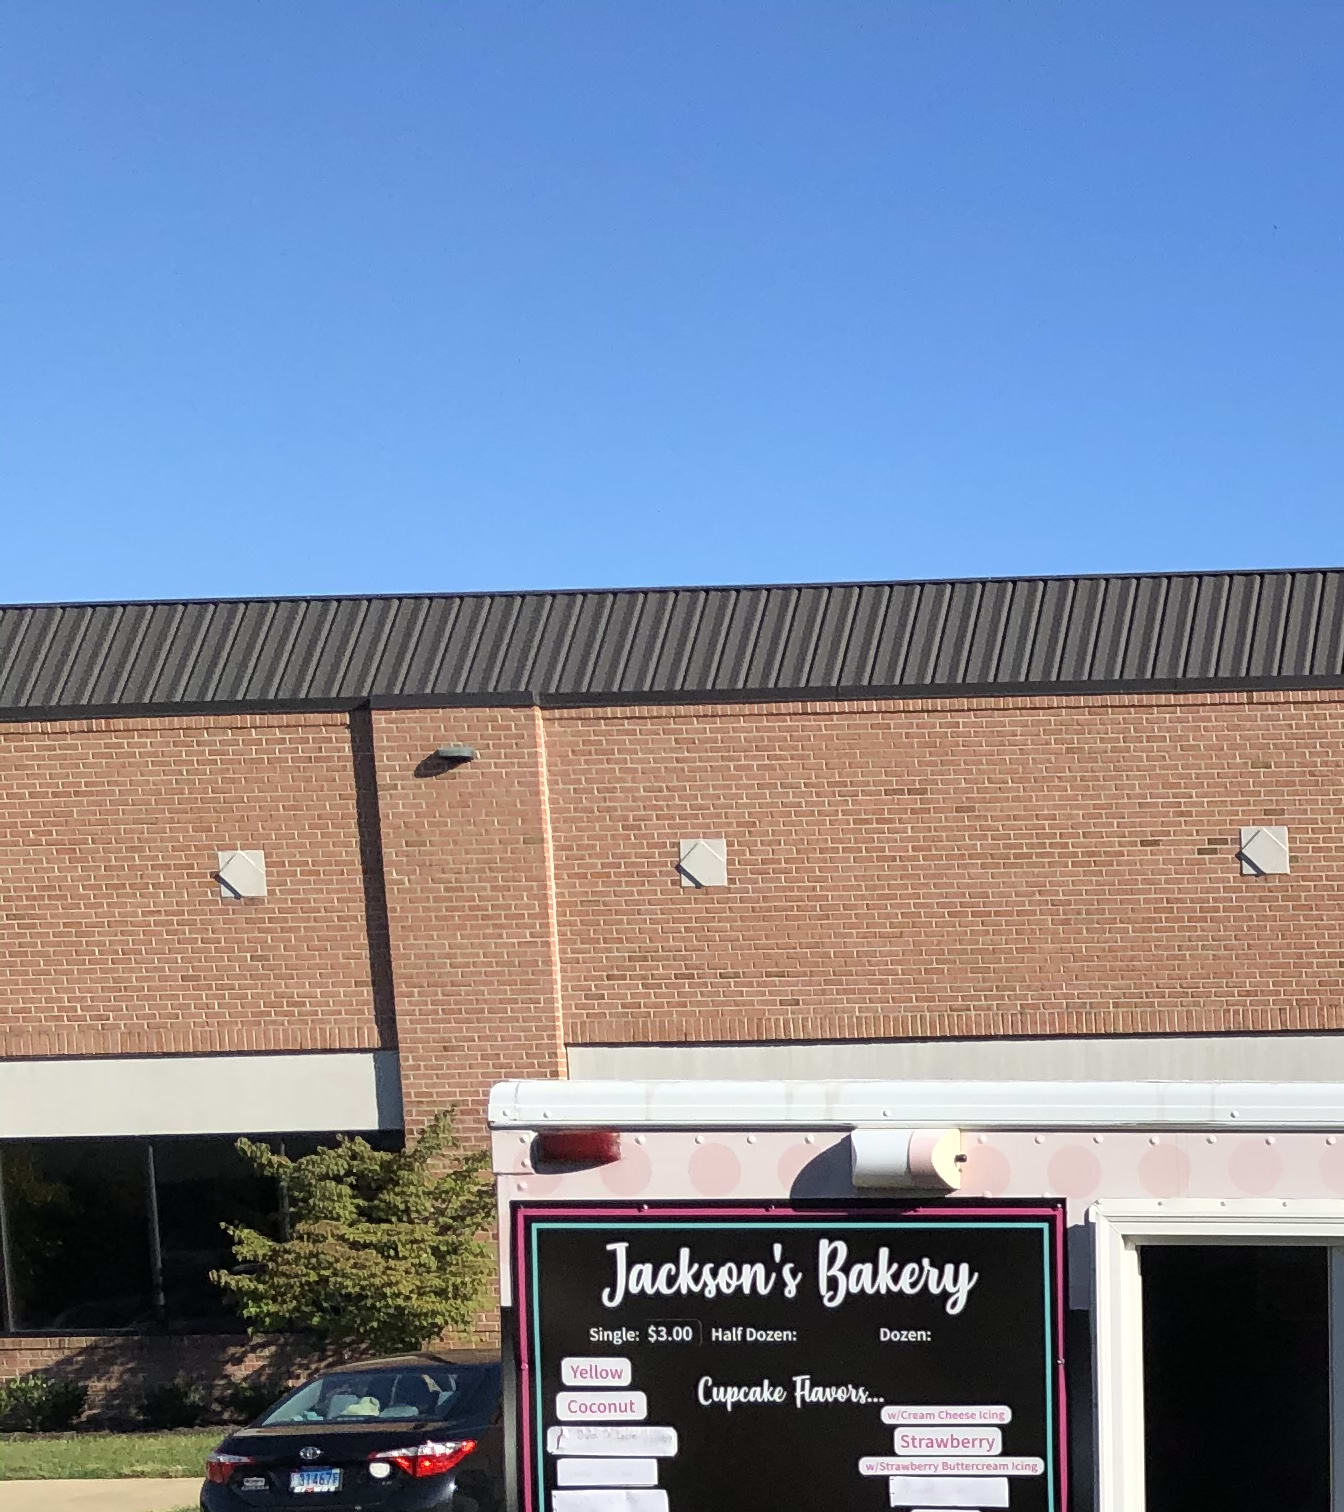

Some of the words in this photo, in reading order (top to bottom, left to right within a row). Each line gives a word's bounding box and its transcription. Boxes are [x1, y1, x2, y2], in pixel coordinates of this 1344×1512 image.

[602, 1242, 802, 1307] Jackson's
[819, 1239, 978, 1314] Bakery
[590, 1327, 639, 1344] Single:
[648, 1325, 692, 1343] $3.00
[711, 1327, 742, 1342] Half
[746, 1327, 797, 1342] Dozen:
[880, 1328, 931, 1341] Dozen:
[570, 1365, 623, 1380] Yellow
[698, 1376, 787, 1411] Cupcake
[567, 1399, 636, 1414] Coconut
[887, 1411, 936, 1421] w/Cream
[938, 1411, 976, 1420] Cheese
[979, 1411, 1006, 1423] Icing
[900, 1433, 996, 1452] Strawberry
[865, 1461, 939, 1473] w/Strawberry
[942, 1461, 1009, 1471] Buttercream
[1012, 1462, 1039, 1473] Icing
